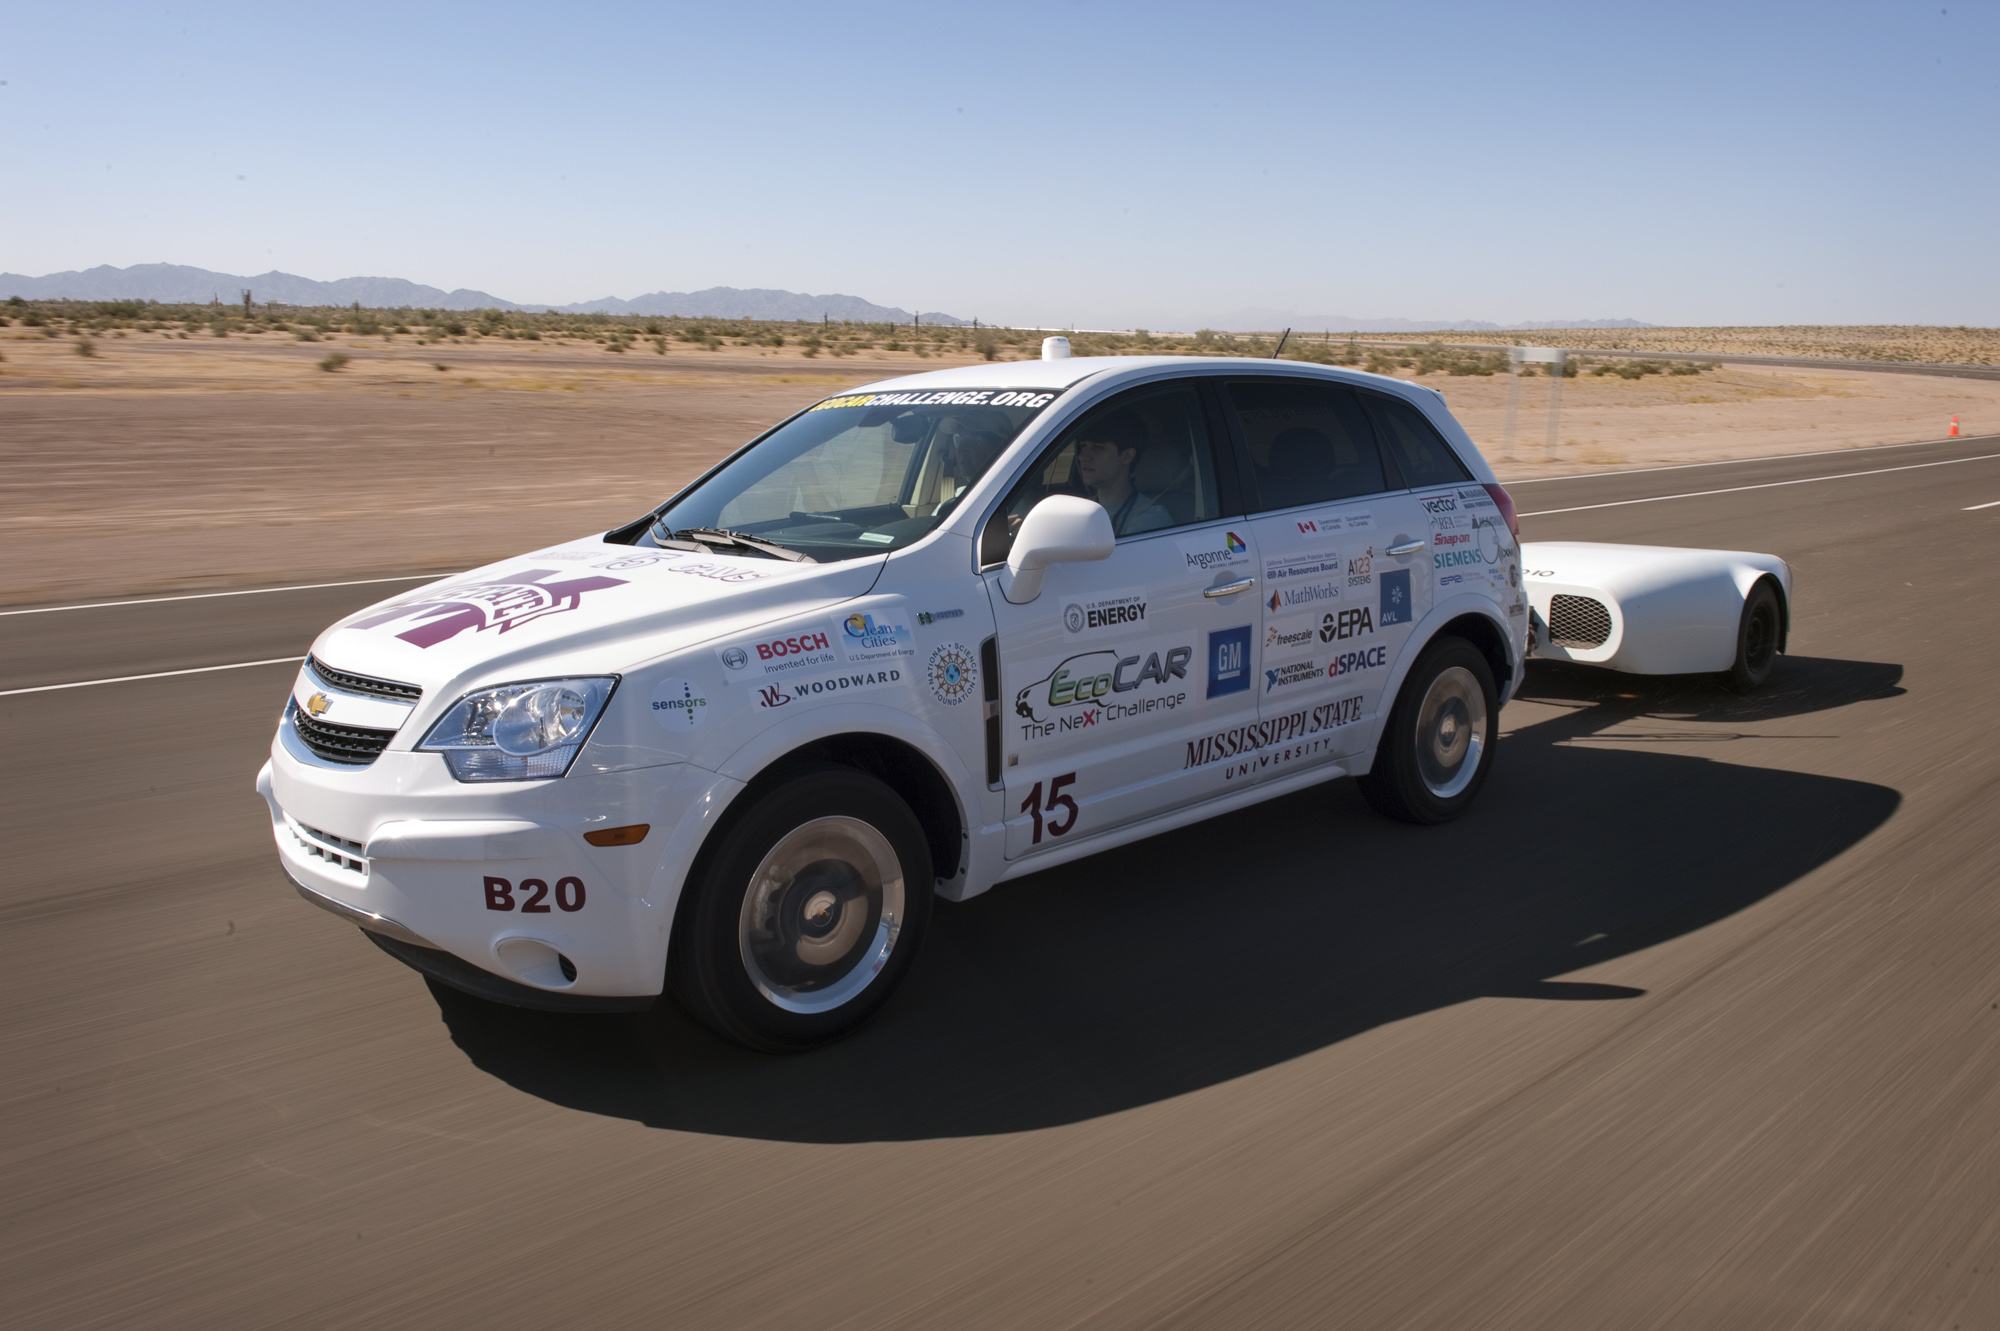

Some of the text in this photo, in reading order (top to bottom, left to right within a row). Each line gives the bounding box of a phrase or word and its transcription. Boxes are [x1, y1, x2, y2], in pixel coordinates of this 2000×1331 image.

[1422, 497, 1457, 514] vector
[1439, 516, 1455, 530] RFA
[1434, 533, 1470, 547] Snap-on
[1186, 549, 1232, 569] Argonne
[1228, 558, 1249, 566] LABORATORY
[1266, 559, 1283, 567] California
[1348, 556, 1370, 576] A123
[1434, 549, 1482, 569] SIEMENS
[1277, 570, 1287, 579] Air
[1289, 565, 1319, 577] Resources
[1320, 561, 1338, 571] Board
[1348, 575, 1371, 587] SYSTEMS
[1098, 597, 1132, 608] DEPARTMENT
[1284, 584, 1339, 606] MathWorks
[1087, 602, 1146, 628] ENERGY
[1337, 606, 1374, 640] EPA
[1382, 612, 1397, 624] AVL
[843, 618, 893, 638] Clean
[1277, 629, 1312, 646] freescale
[756, 632, 830, 660] BOSCH
[862, 636, 896, 648] Cities
[764, 651, 835, 674] Invented for life
[860, 651, 891, 661] Department
[928, 644, 946, 685] NATIONAL
[954, 643, 977, 674] SCIENCE
[1218, 642, 1241, 672] GM
[1328, 646, 1386, 678] dSPACE
[1048, 646, 1192, 707] EcoCAR
[1278, 667, 1324, 687] INSTRUMENTS
[1280, 661, 1314, 675] NATIONAL
[795, 669, 900, 698] WOODWARD
[933, 681, 976, 706] FOUNDATION
[652, 695, 707, 711] sensors
[1021, 692, 1186, 741] The NeXt Challenge
[1183, 695, 1364, 770] MISSISSIPPI STATE
[1226, 738, 1331, 780] UNIVERSITY
[1021, 772, 1078, 845] 15
[483, 876, 586, 913] B20
